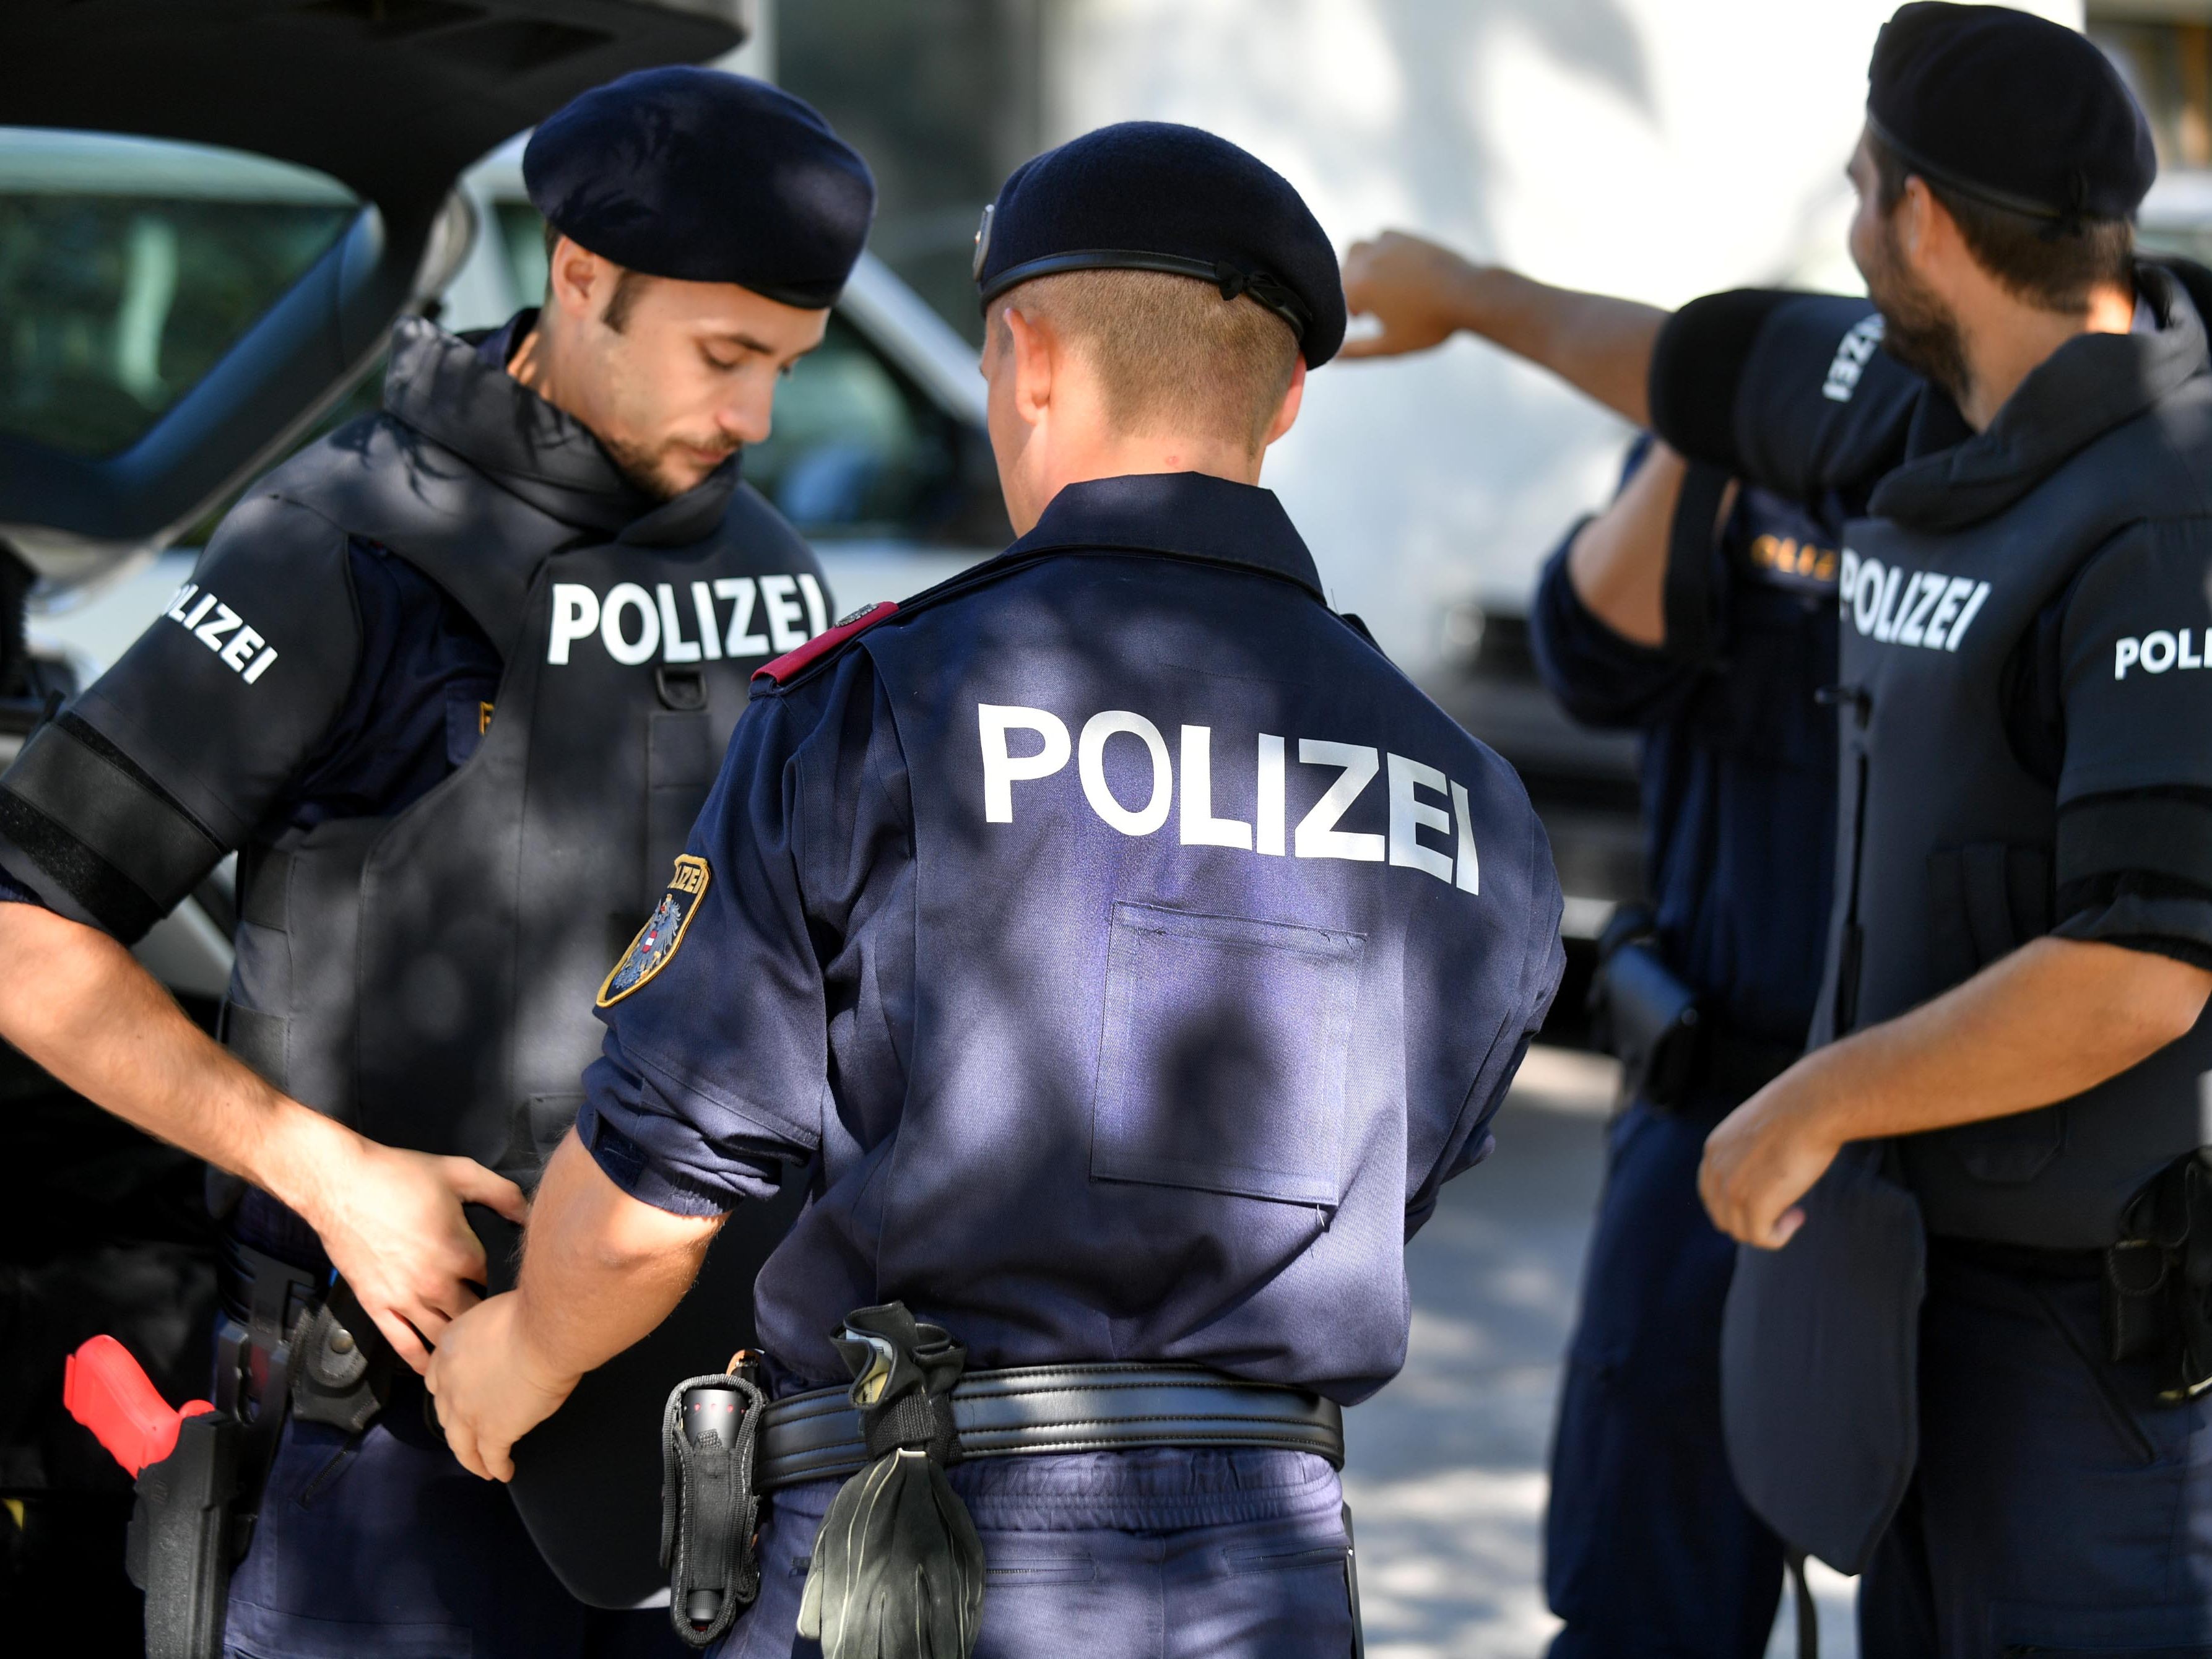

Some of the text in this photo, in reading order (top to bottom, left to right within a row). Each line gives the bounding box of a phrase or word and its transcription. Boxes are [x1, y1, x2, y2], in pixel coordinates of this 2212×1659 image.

[167, 583, 278, 685] LIZEI
[547, 573, 828, 665] POLIZEI
[1839, 547, 1992, 652] POLIZEI
[2115, 627, 2212, 680] POLI
[978, 703, 1479, 896] POLIZEI
